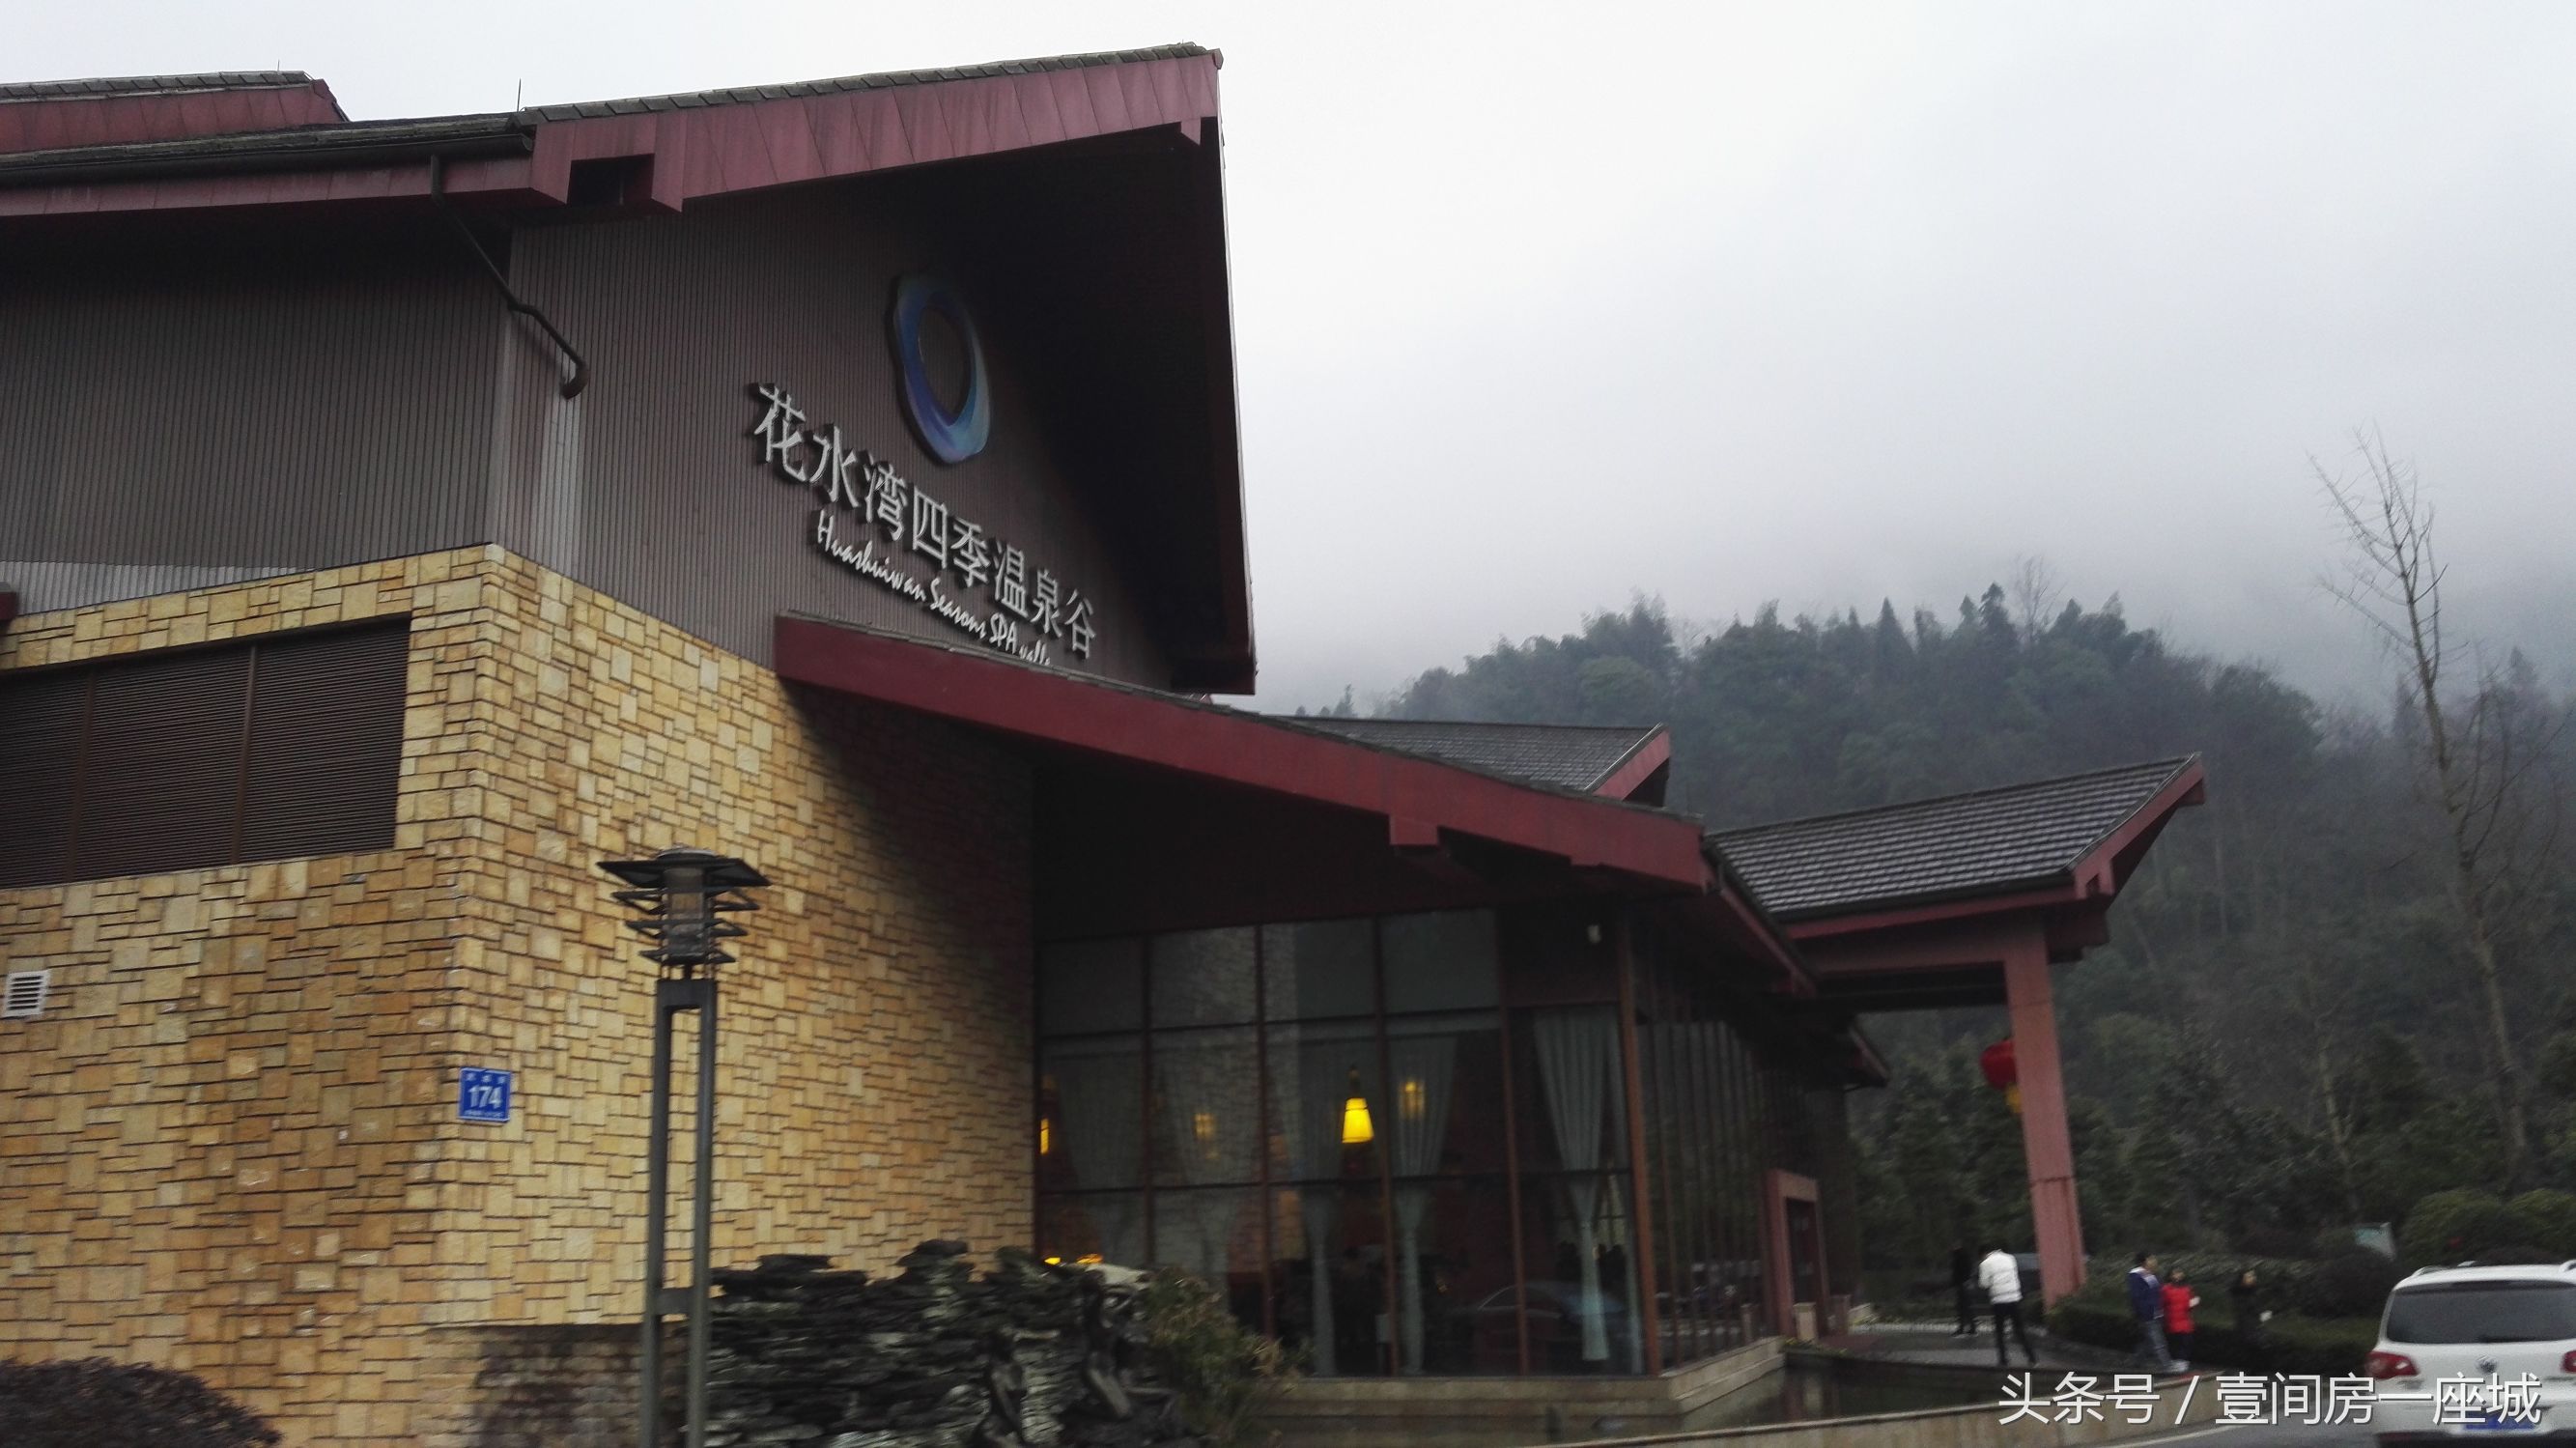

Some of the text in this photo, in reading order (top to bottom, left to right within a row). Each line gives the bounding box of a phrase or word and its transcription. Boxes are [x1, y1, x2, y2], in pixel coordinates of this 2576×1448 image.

[754, 384, 1095, 659] 花水湾四季温泉谷
[989, 611, 1018, 655] SPA
[468, 1085, 502, 1109] 174
